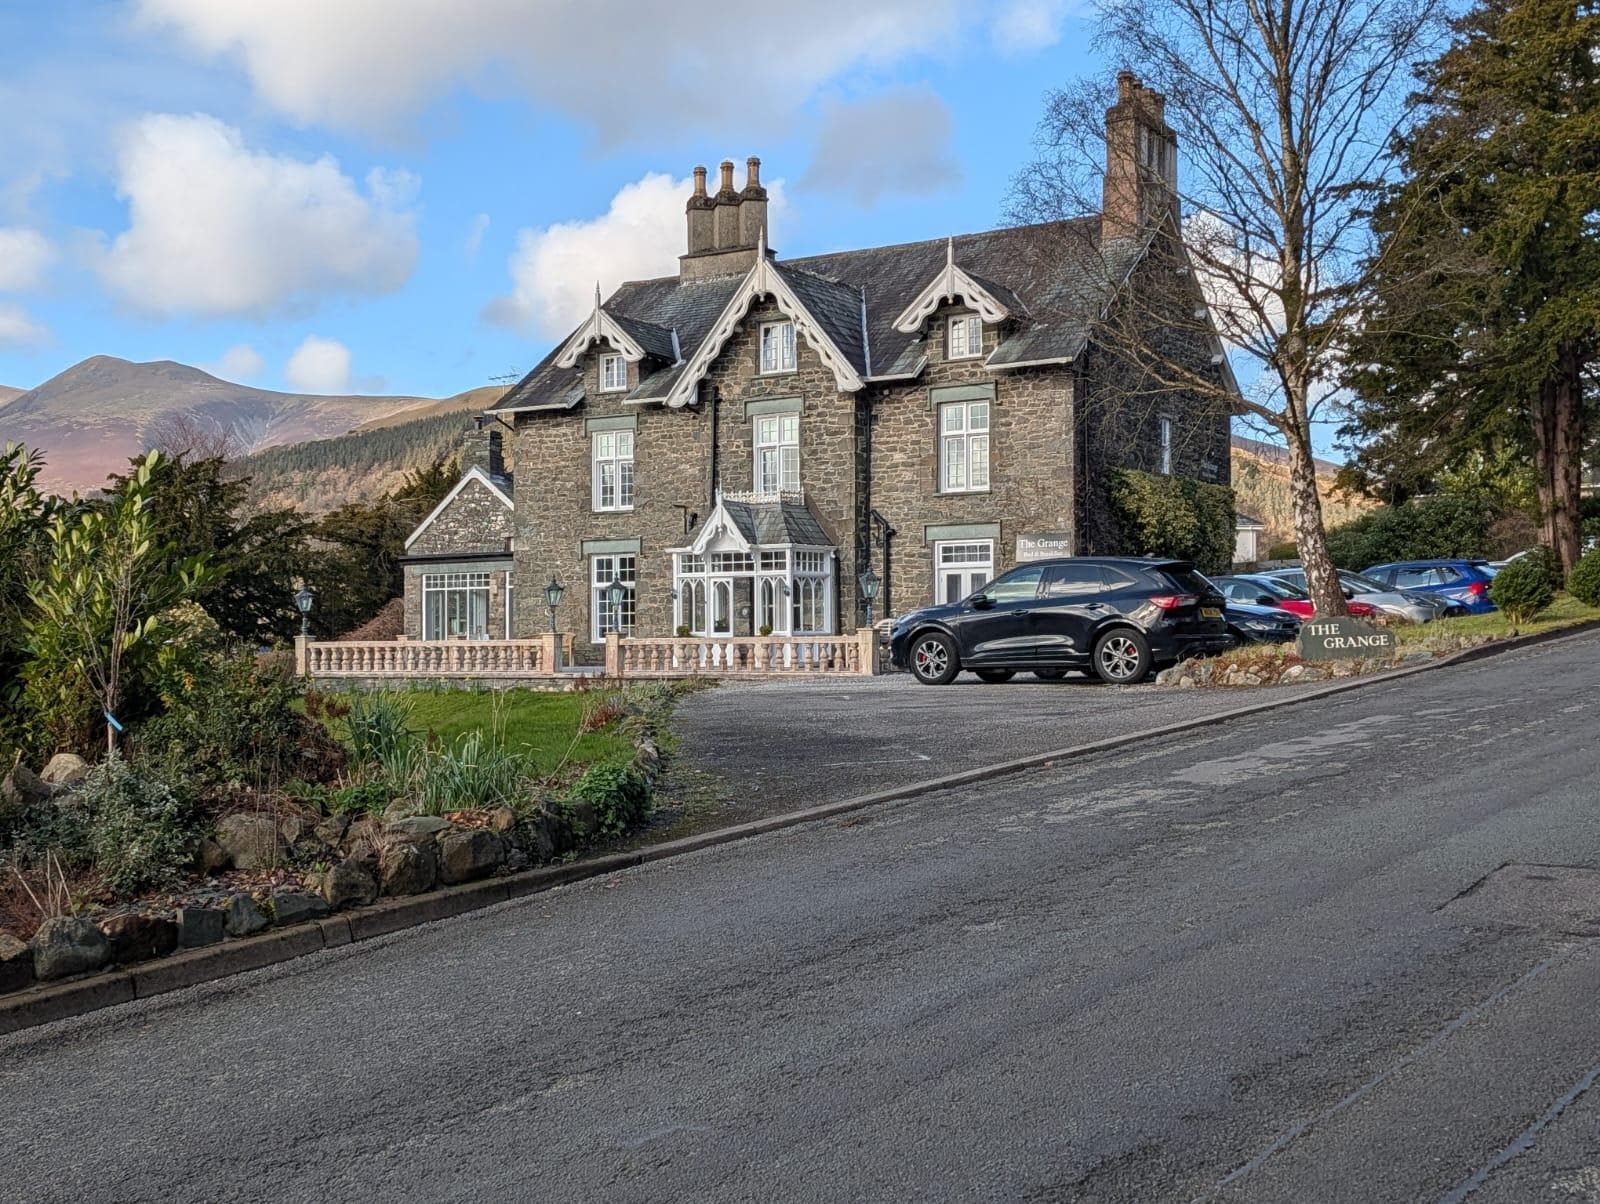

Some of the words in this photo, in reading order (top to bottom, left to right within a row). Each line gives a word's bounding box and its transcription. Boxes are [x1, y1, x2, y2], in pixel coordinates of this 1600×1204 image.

[1019, 539, 1035, 549] The
[1037, 538, 1068, 550] Grange
[1307, 623, 1340, 636] THE
[1323, 634, 1390, 649] GRANGE
